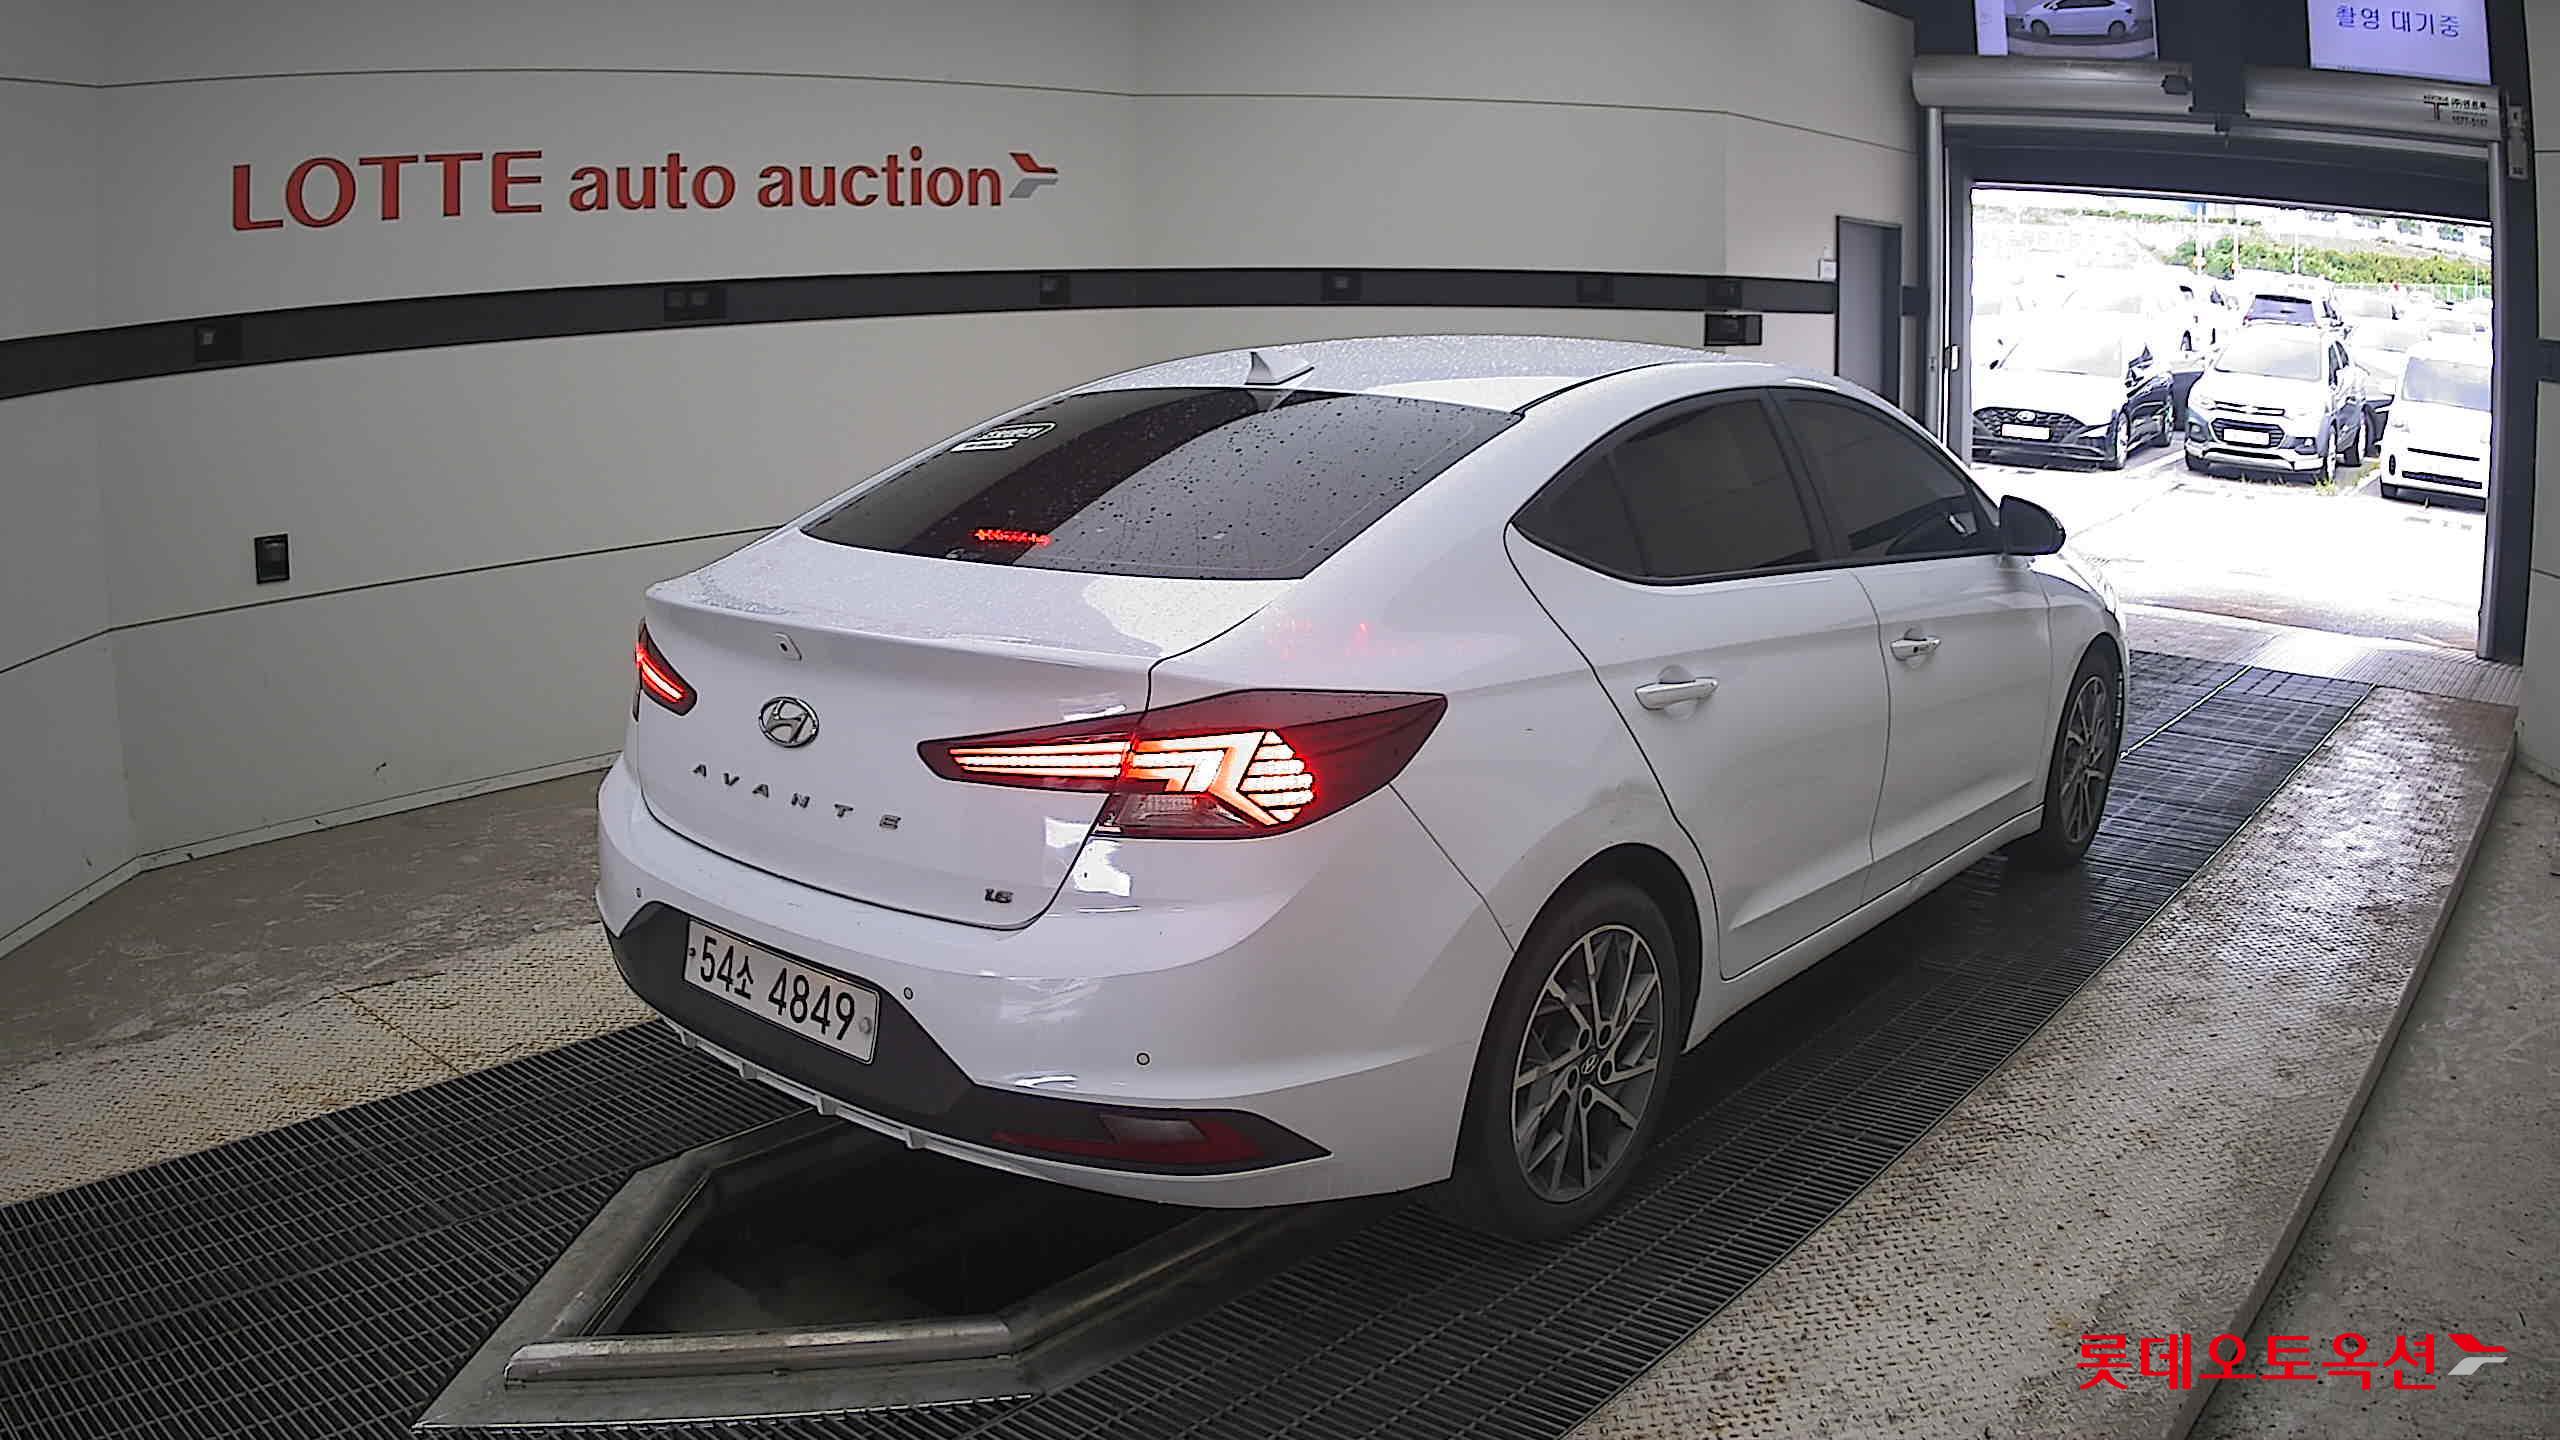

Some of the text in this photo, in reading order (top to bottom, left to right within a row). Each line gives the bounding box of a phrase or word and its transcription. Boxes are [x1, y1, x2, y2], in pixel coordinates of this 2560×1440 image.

[2336, 5, 2460, 38] 촬영 대기중
[232, 146, 1001, 231] LOTTE auto auction
[692, 763, 901, 830] AVANTE
[700, 935, 856, 1041] 54소 4849
